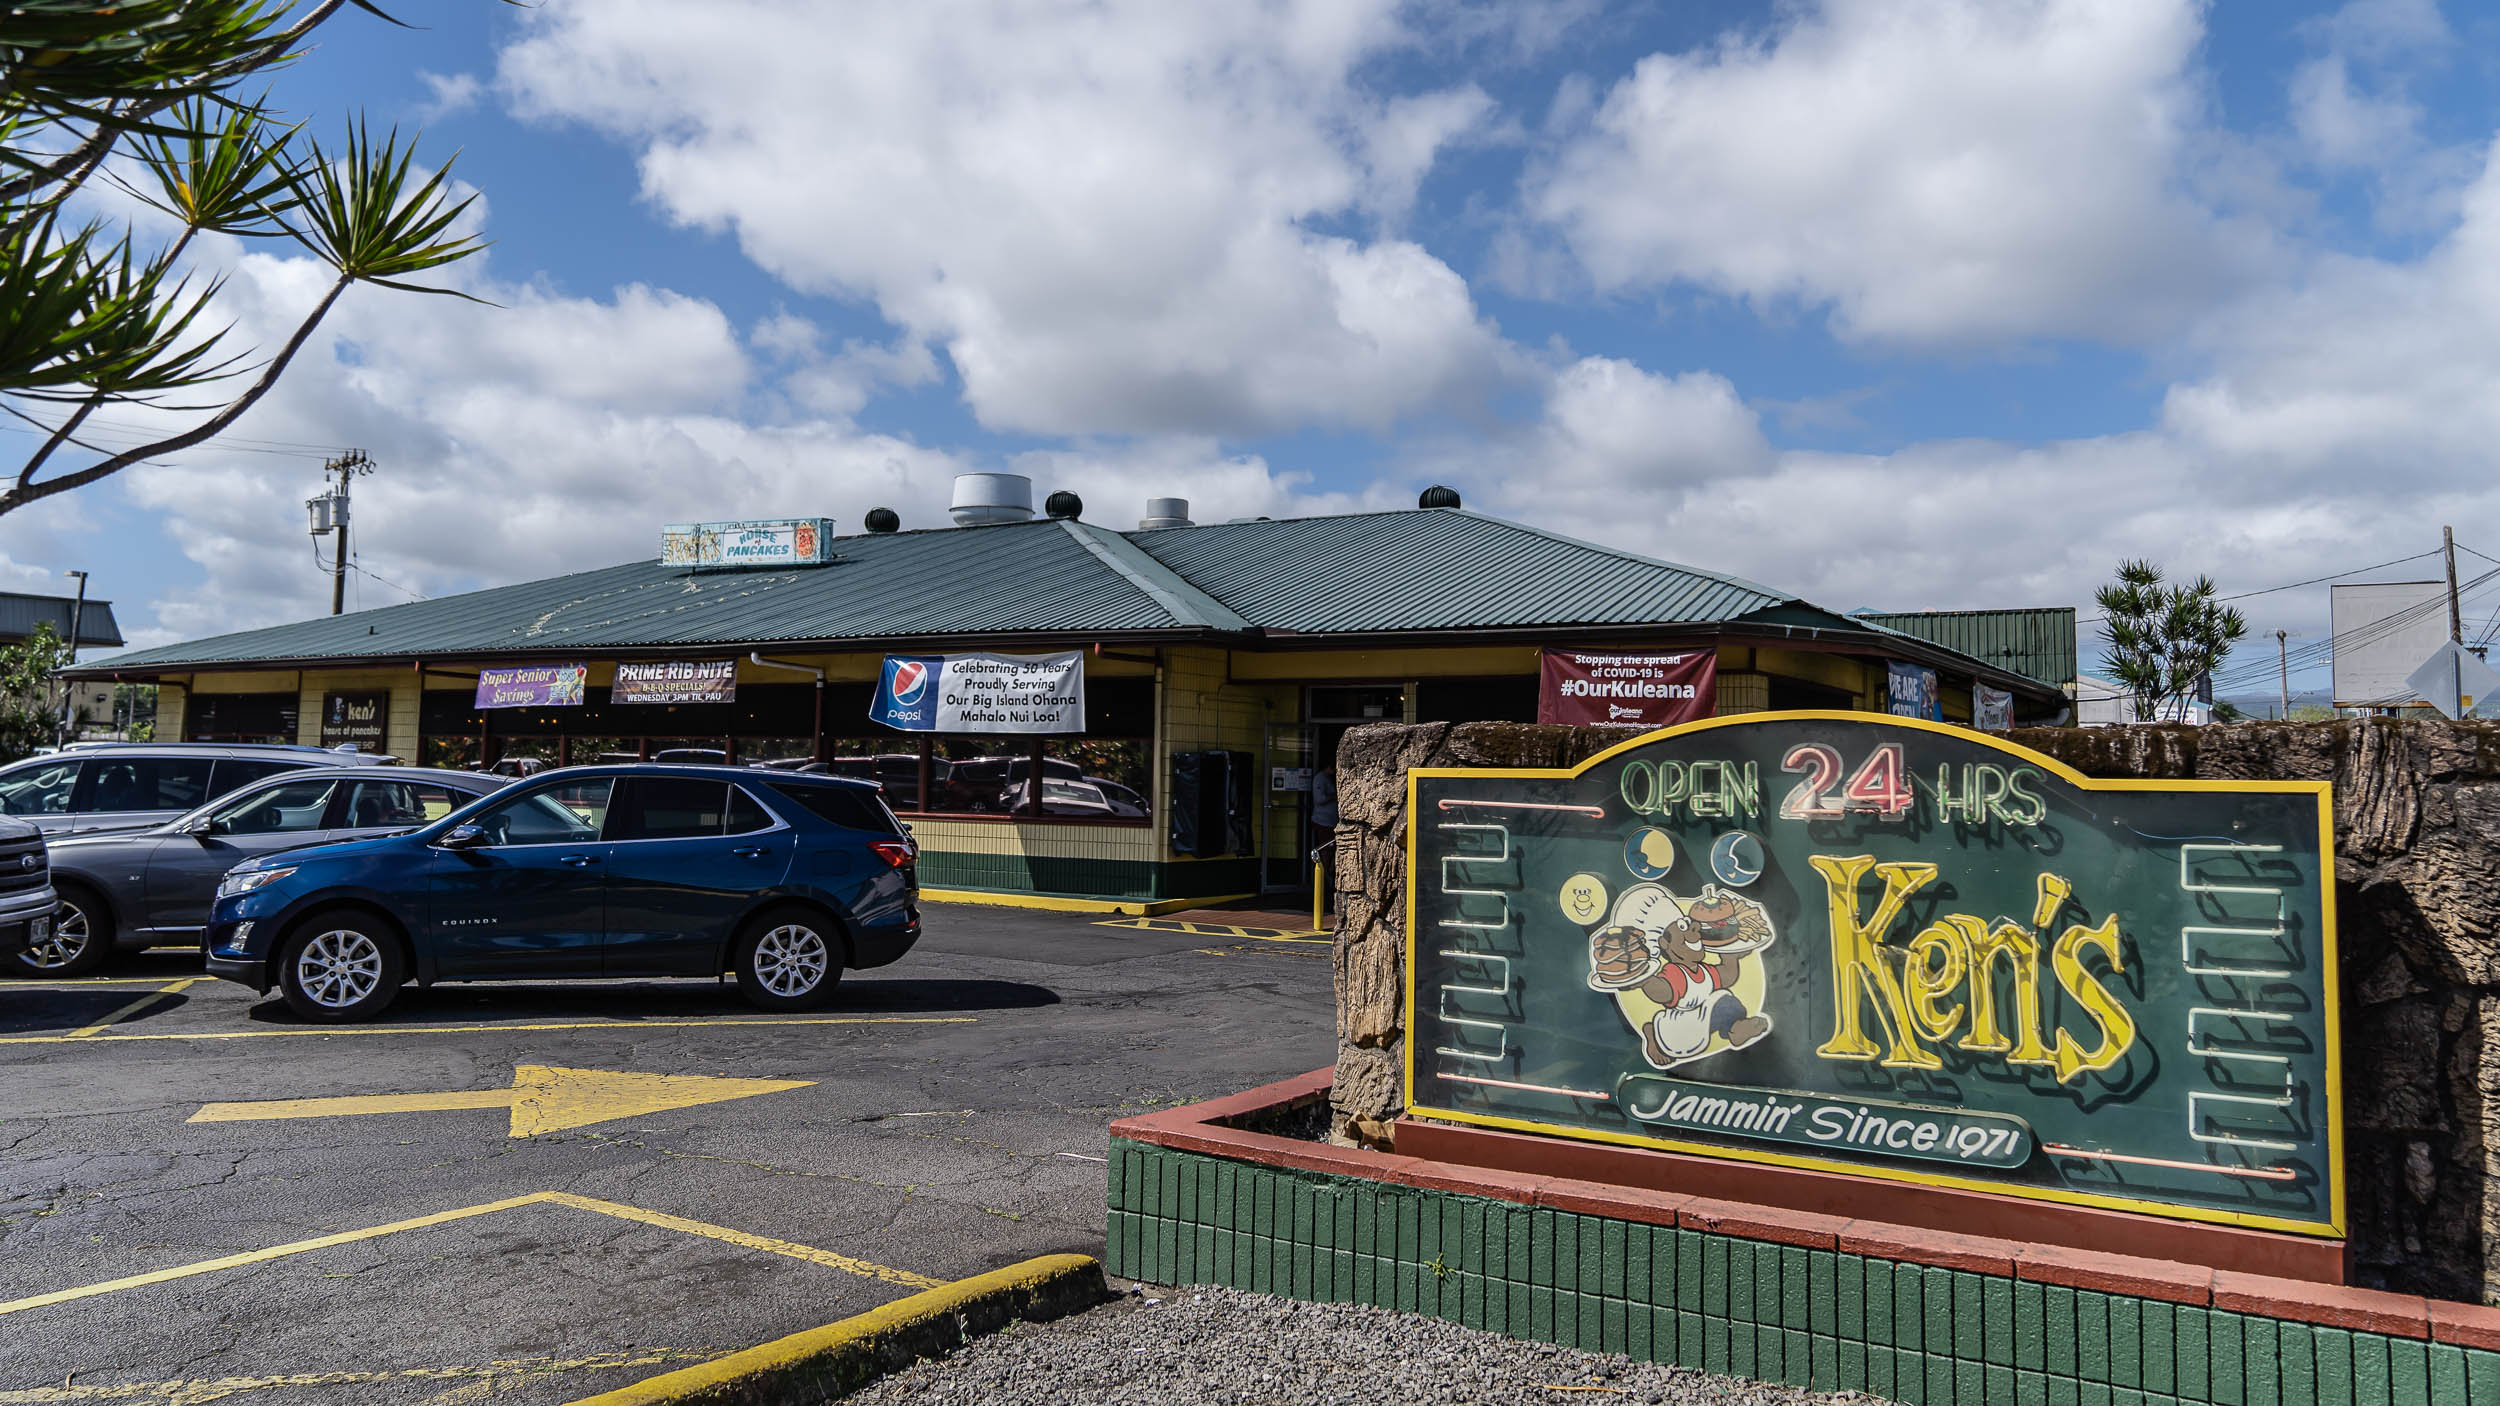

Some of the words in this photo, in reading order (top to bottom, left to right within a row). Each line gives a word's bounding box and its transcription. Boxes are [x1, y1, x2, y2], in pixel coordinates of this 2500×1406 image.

[738, 528, 777, 545] HOUSE
[726, 544, 790, 558] PANCAKES
[1575, 654, 1622, 667] Stopping
[1623, 655, 1642, 665] the
[1643, 655, 1681, 667] spread
[619, 664, 665, 681] PRIME
[667, 662, 695, 680] RIB
[697, 661, 734, 679] NITE
[951, 662, 1019, 677] Celebrating
[1022, 663, 1038, 675] 50
[1041, 662, 1072, 674] Years
[1591, 668, 1603, 678] of
[1603, 668, 1652, 678] COVID-19
[1653, 668, 1664, 679] is
[481, 671, 514, 687] Super
[515, 668, 552, 684] Senior
[665, 682, 706, 692] SPECIALS!
[964, 678, 1009, 692] Proudly
[1011, 679, 1056, 692] Serving
[1560, 679, 1696, 699] #OurKuleana
[1888, 672, 1903, 700] WE
[1903, 676, 1919, 702] ARE
[493, 688, 535, 704] Savings
[627, 694, 670, 702] WEDNESDAY
[705, 692, 722, 701] PAU
[946, 694, 969, 706] Our
[973, 694, 992, 708] Big
[996, 694, 1029, 706] Island
[1032, 694, 1077, 706] Ohana
[887, 709, 922, 723] pepsi
[960, 710, 1006, 722] Mahalo
[1009, 710, 1030, 722] Nui
[1033, 710, 1060, 722] Loa!
[323, 725, 342, 736] house
[351, 725, 381, 737] pancakes
[1620, 759, 1759, 818] OPEN
[1779, 742, 1914, 821] 24
[1937, 761, 2048, 826] HRS
[442, 918, 498, 926] EQUINOX
[1808, 854, 2137, 1085] Ken's
[1630, 1089, 1804, 1134] Jammin'
[1805, 1106, 1939, 1151] Since
[1945, 1124, 2021, 1159] 1971
